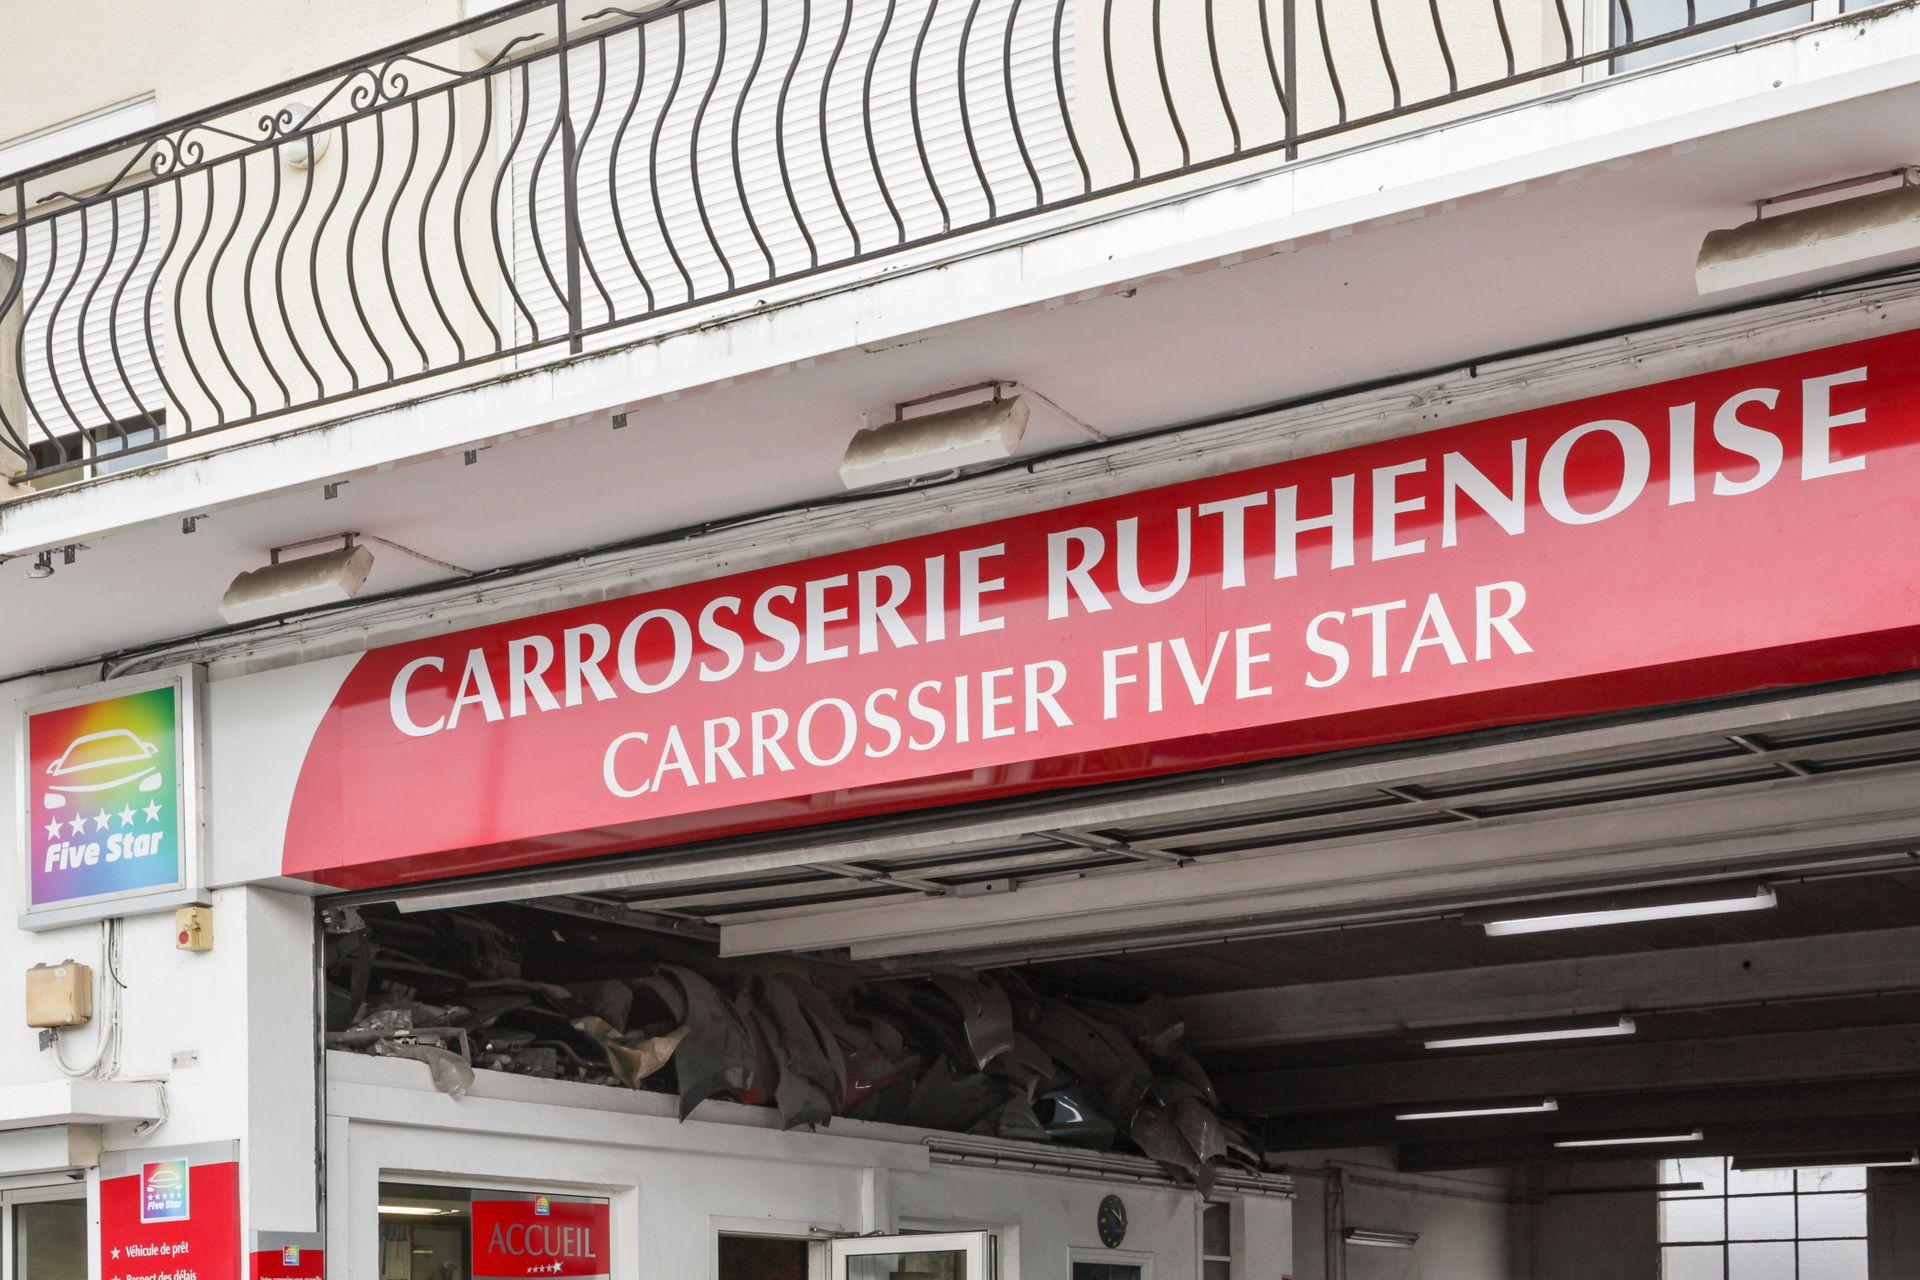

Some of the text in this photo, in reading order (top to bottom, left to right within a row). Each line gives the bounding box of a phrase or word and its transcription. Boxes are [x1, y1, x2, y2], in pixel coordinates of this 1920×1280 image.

[388, 366, 1868, 738] CARROSSERIE RUTHENOISE
[603, 580, 1534, 798] CARROSSIER FIVE STAR
[44, 830, 163, 873] Five Star
[147, 1200, 182, 1211] Five Star
[125, 1241, 189, 1258] Véhicule de prêt
[488, 1222, 596, 1258] ACCUEIL
